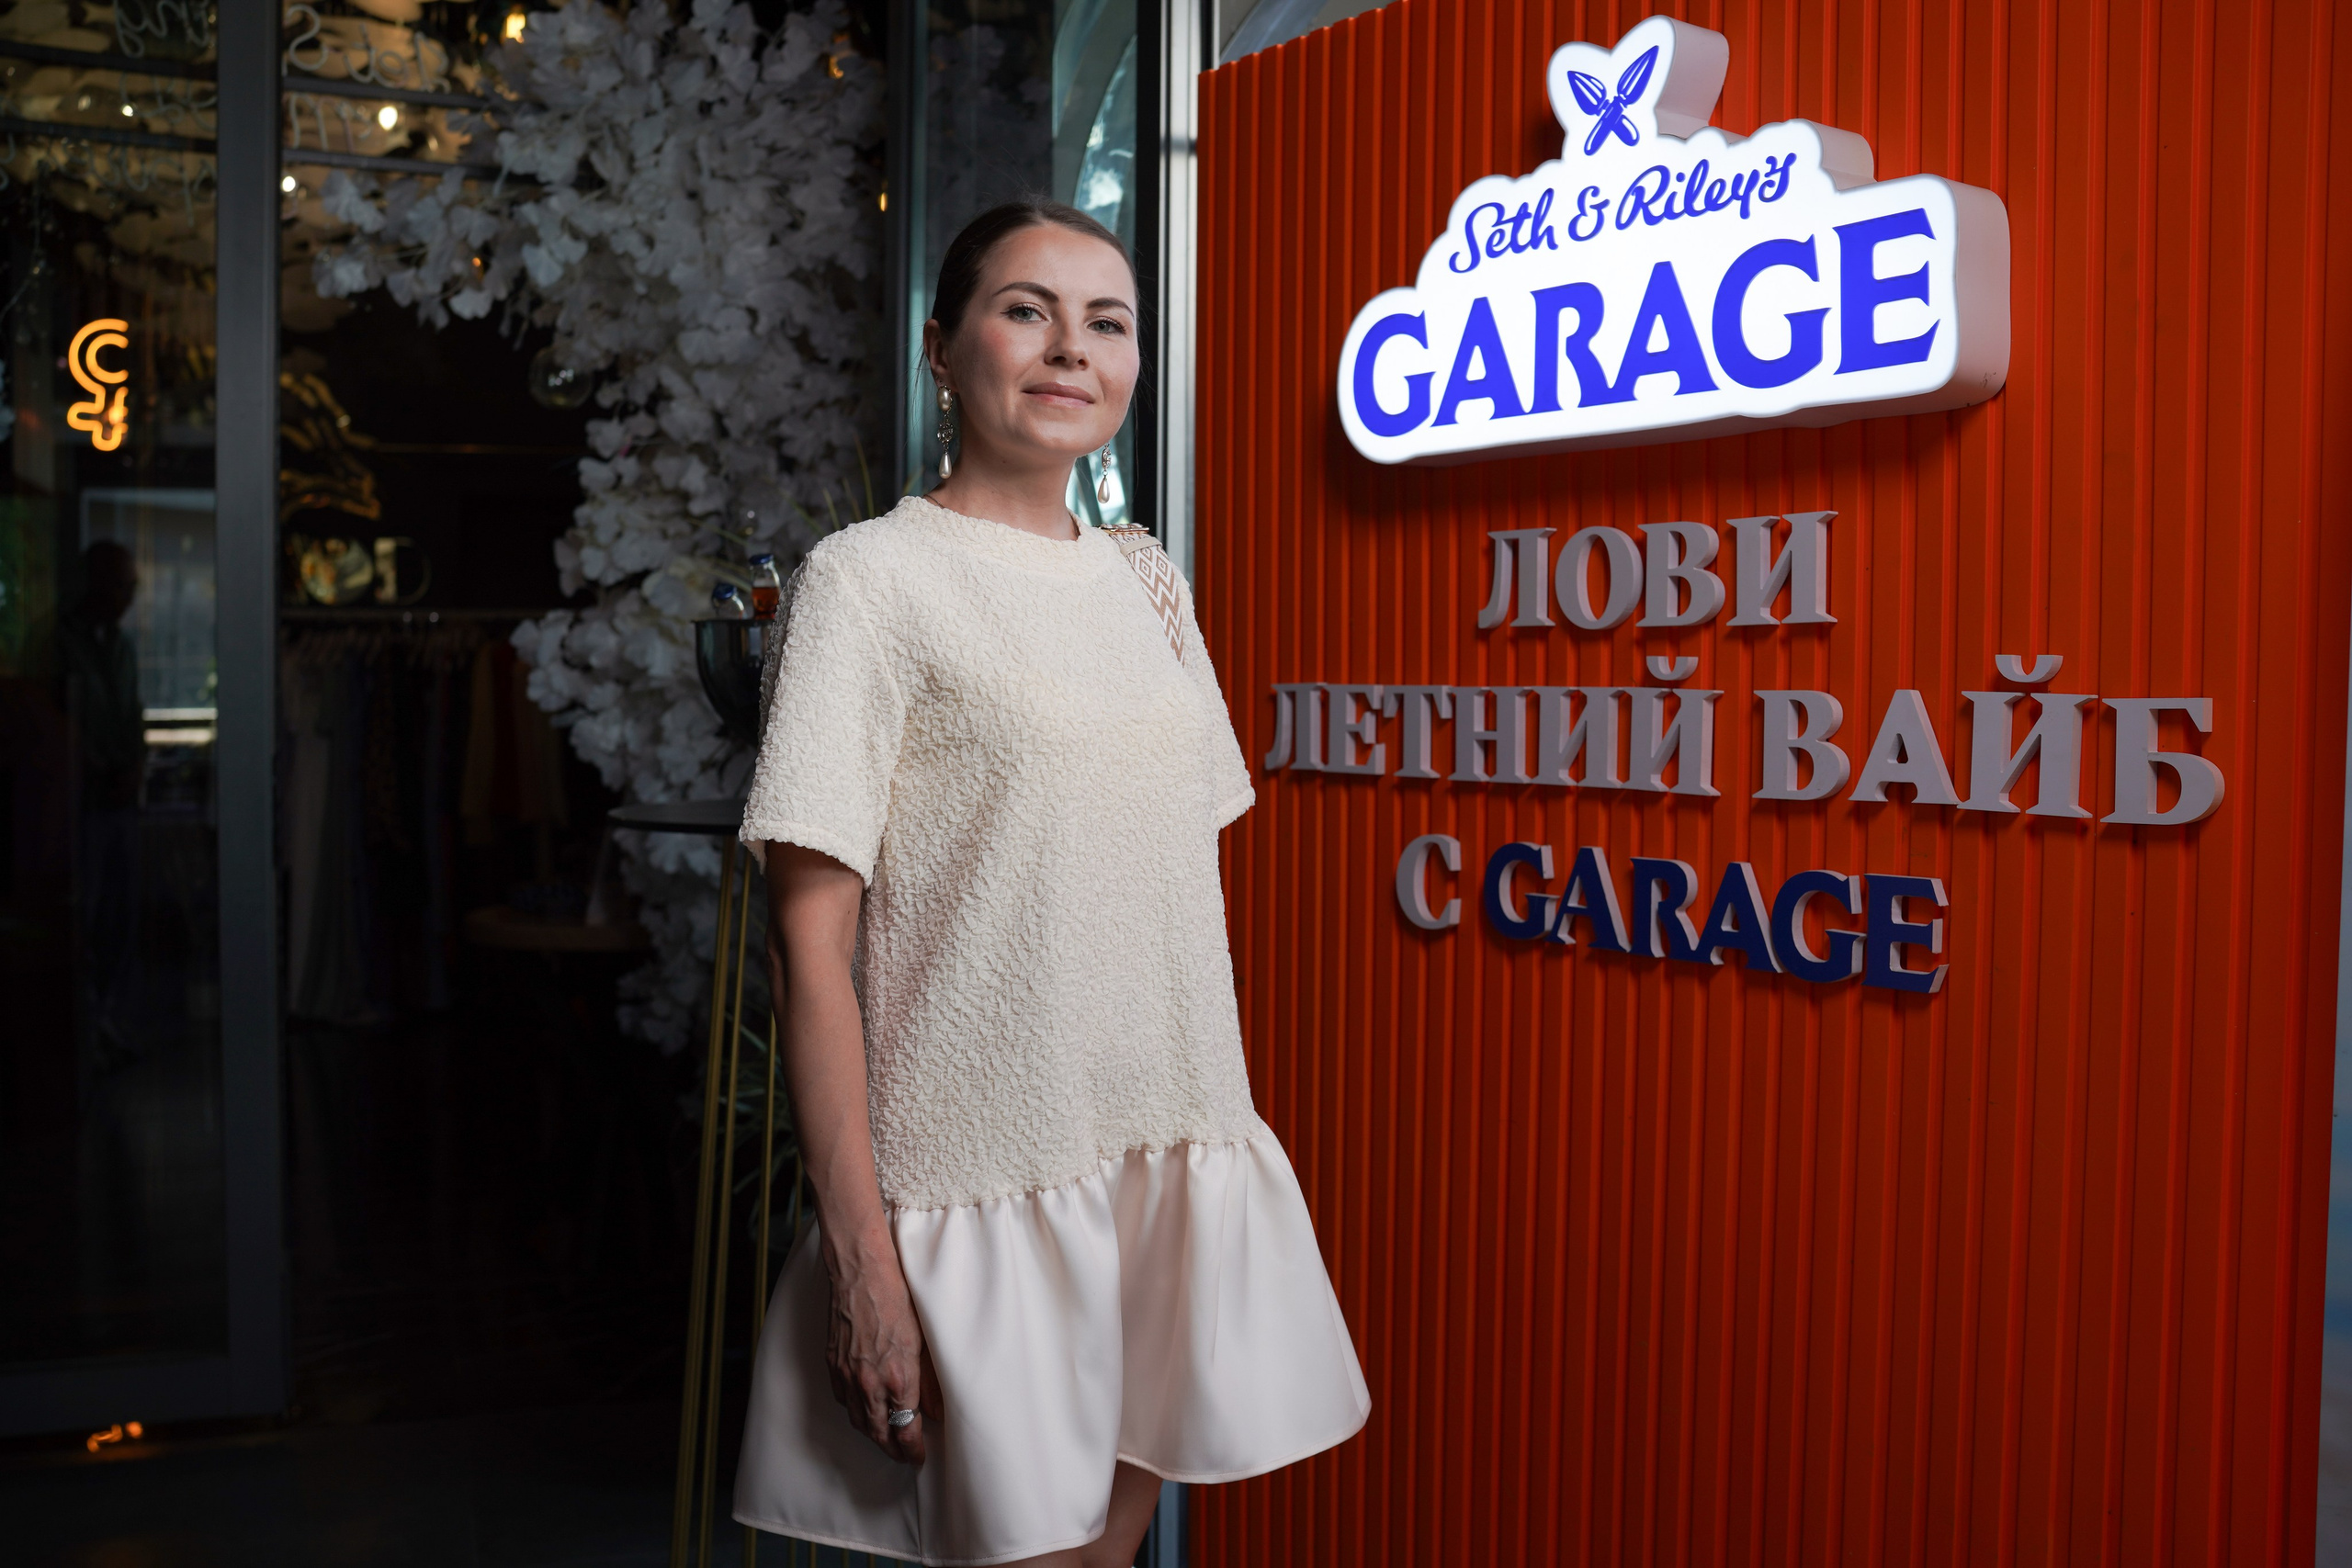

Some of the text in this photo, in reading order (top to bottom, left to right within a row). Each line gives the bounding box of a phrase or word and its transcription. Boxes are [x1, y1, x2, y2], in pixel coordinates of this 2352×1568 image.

[1449, 152, 1797, 274] Seth & Riley's
[1352, 208, 1940, 438] GARAGE
[1477, 510, 1838, 630] ЛОВИ
[1265, 654, 2224, 826] ЛЕТНИЙ ВАЙБ
[1483, 841, 1949, 994] GARAGE
